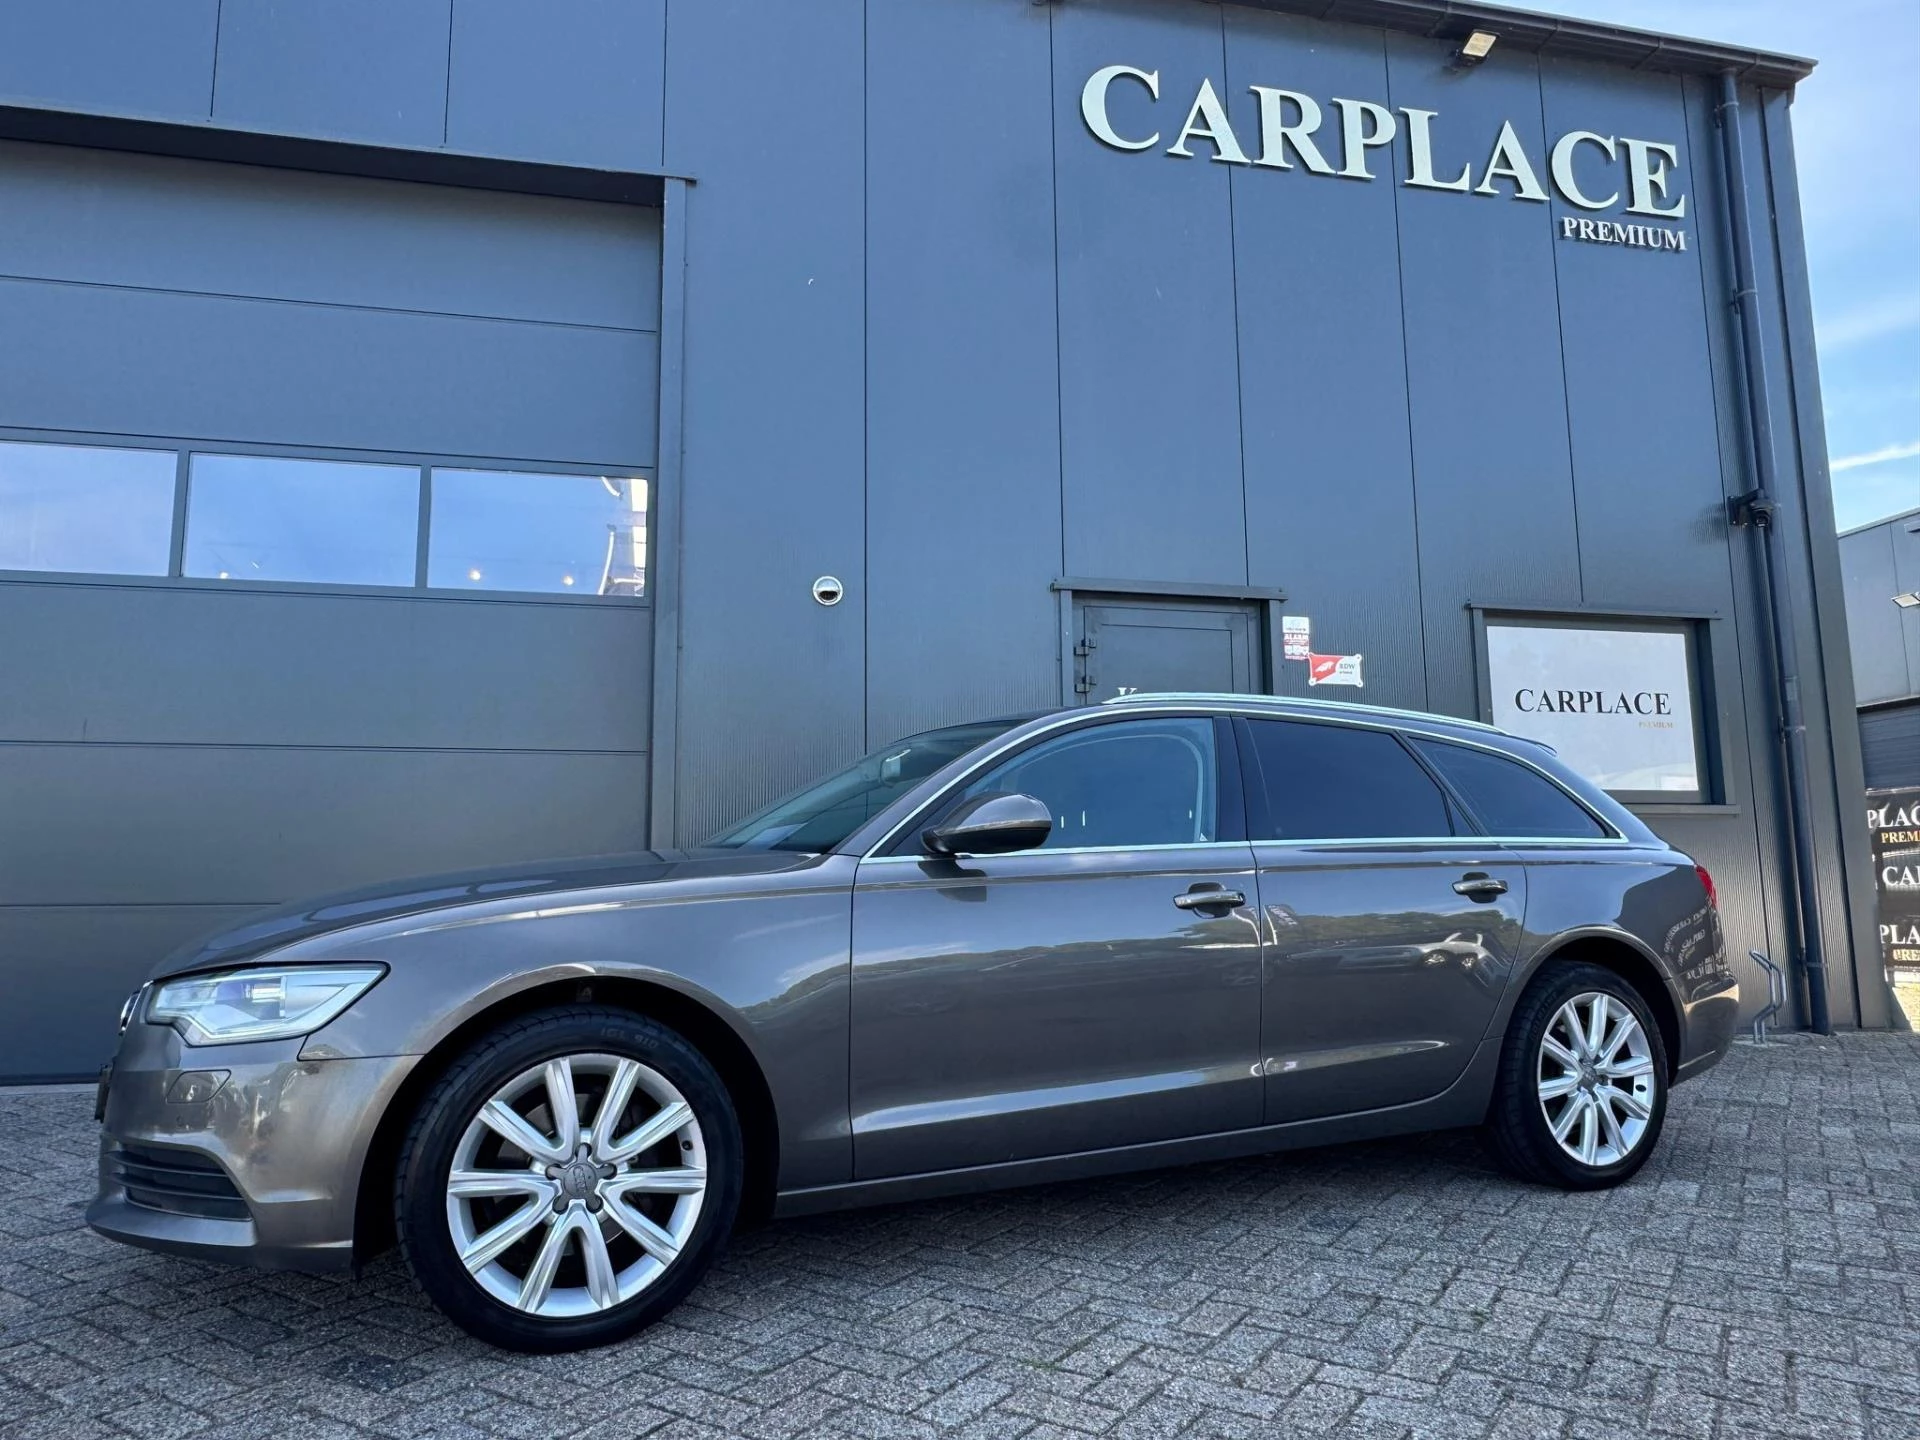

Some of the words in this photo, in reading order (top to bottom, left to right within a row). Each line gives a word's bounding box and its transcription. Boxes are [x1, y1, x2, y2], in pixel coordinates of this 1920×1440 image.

[1081, 65, 1687, 219] CARPLACE
[1561, 216, 1687, 251] PREMIUM
[1515, 688, 1671, 715] CARPLACE
[1881, 830, 1920, 843] PREM
